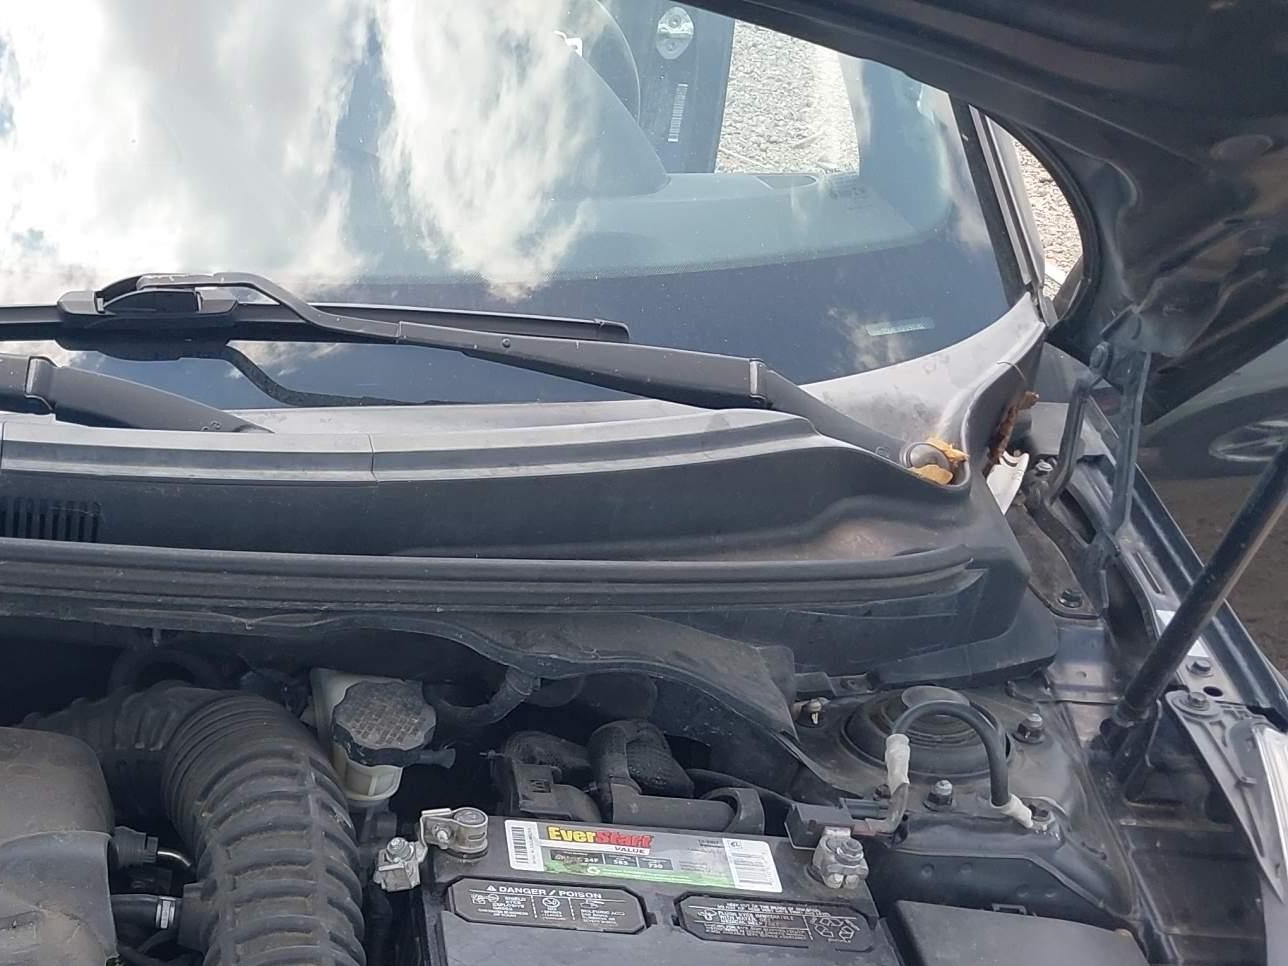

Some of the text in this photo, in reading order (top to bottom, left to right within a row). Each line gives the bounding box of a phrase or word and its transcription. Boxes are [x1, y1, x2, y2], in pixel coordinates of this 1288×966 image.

[547, 826, 654, 848] EverStart
[614, 846, 648, 854] VALUE
[499, 886, 546, 896] DANGER
[558, 890, 602, 899] POISON
